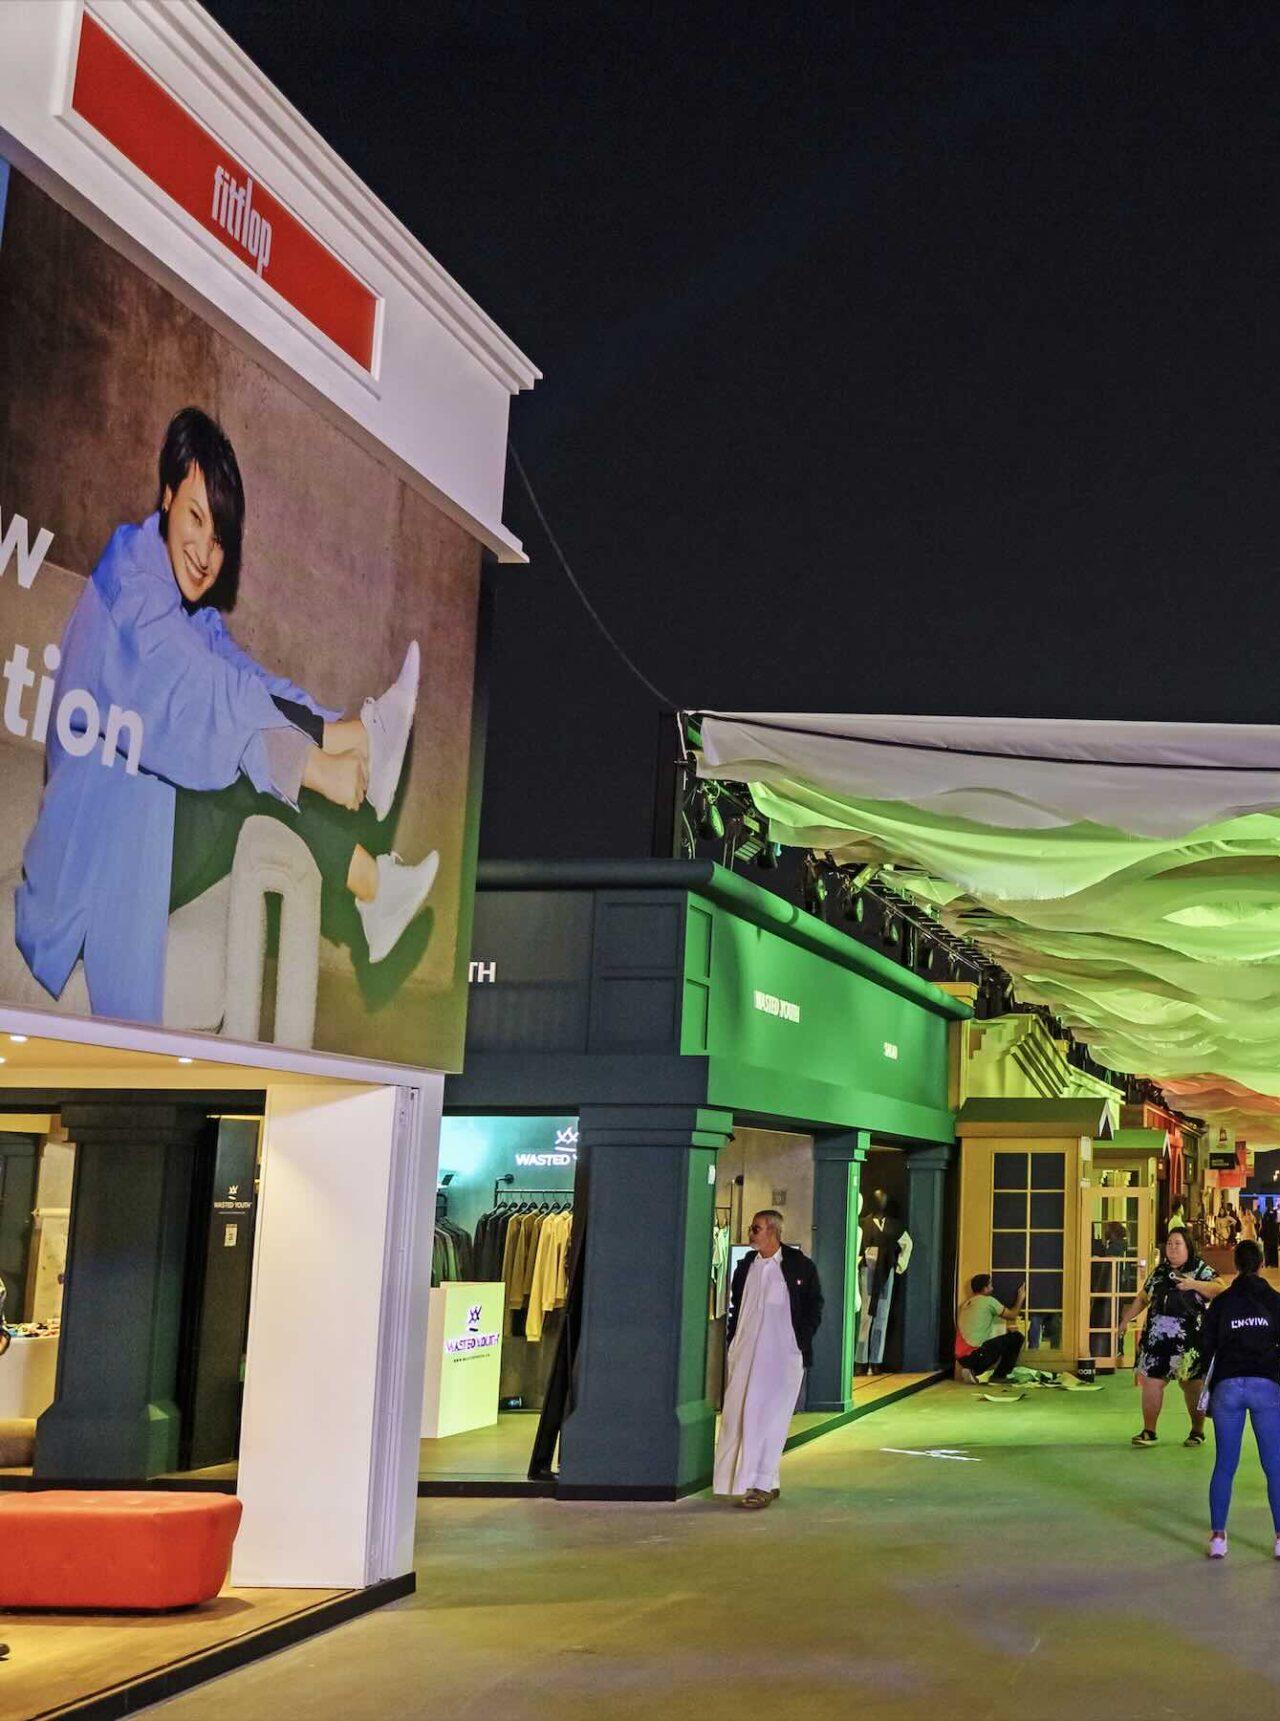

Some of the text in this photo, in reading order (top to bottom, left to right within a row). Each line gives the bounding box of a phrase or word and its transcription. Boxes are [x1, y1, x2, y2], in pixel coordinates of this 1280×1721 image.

[212, 165, 272, 278] fitflop
[3, 643, 144, 776] tion
[515, 1153, 570, 1167] WASTED
